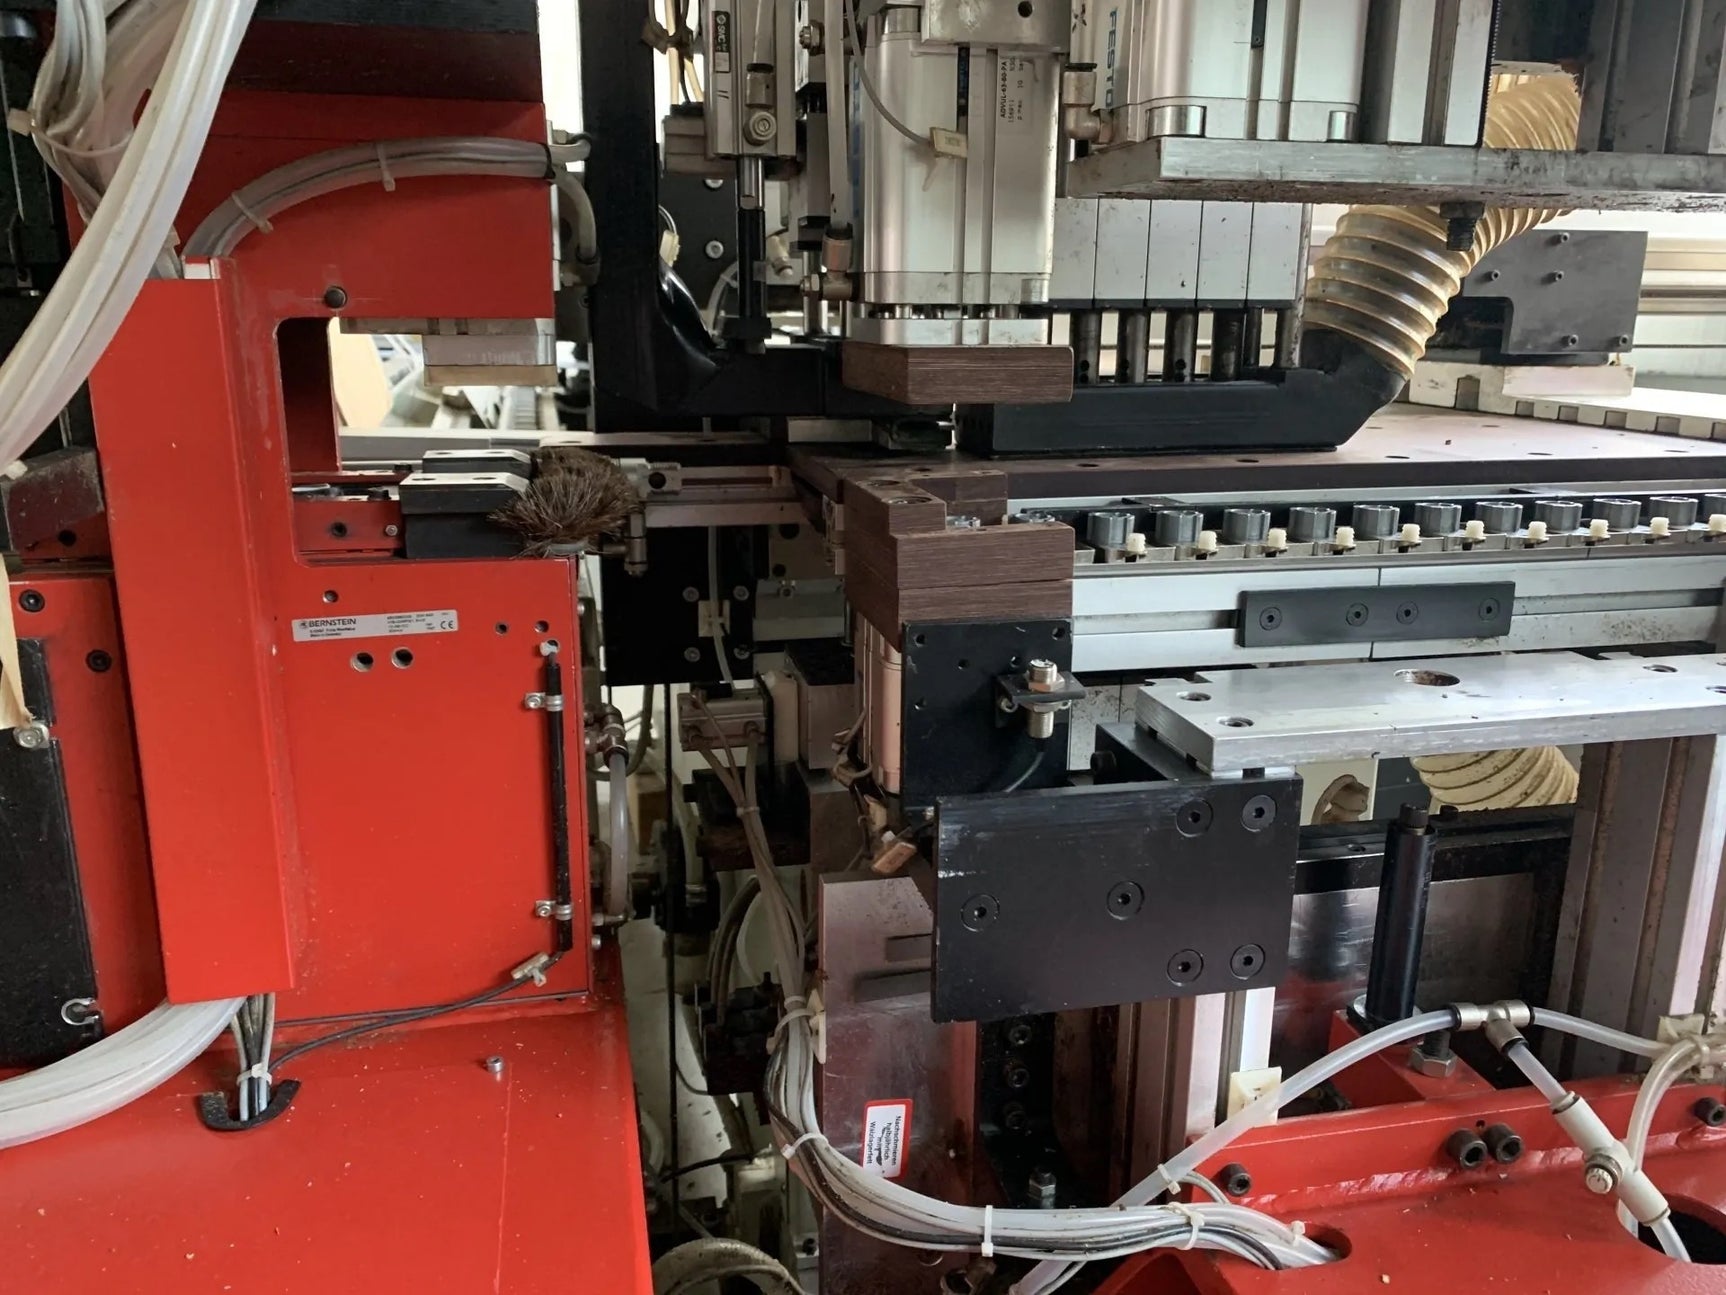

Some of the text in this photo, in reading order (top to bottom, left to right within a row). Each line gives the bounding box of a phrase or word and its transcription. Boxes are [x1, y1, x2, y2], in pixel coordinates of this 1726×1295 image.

[717, 25, 726, 43] SMC
[1105, 7, 1118, 108] FESTO
[308, 618, 357, 628] BERNSTEIN
[883, 1122, 893, 1161] halbjährlich
[891, 1115, 902, 1166] Nachschmieren
